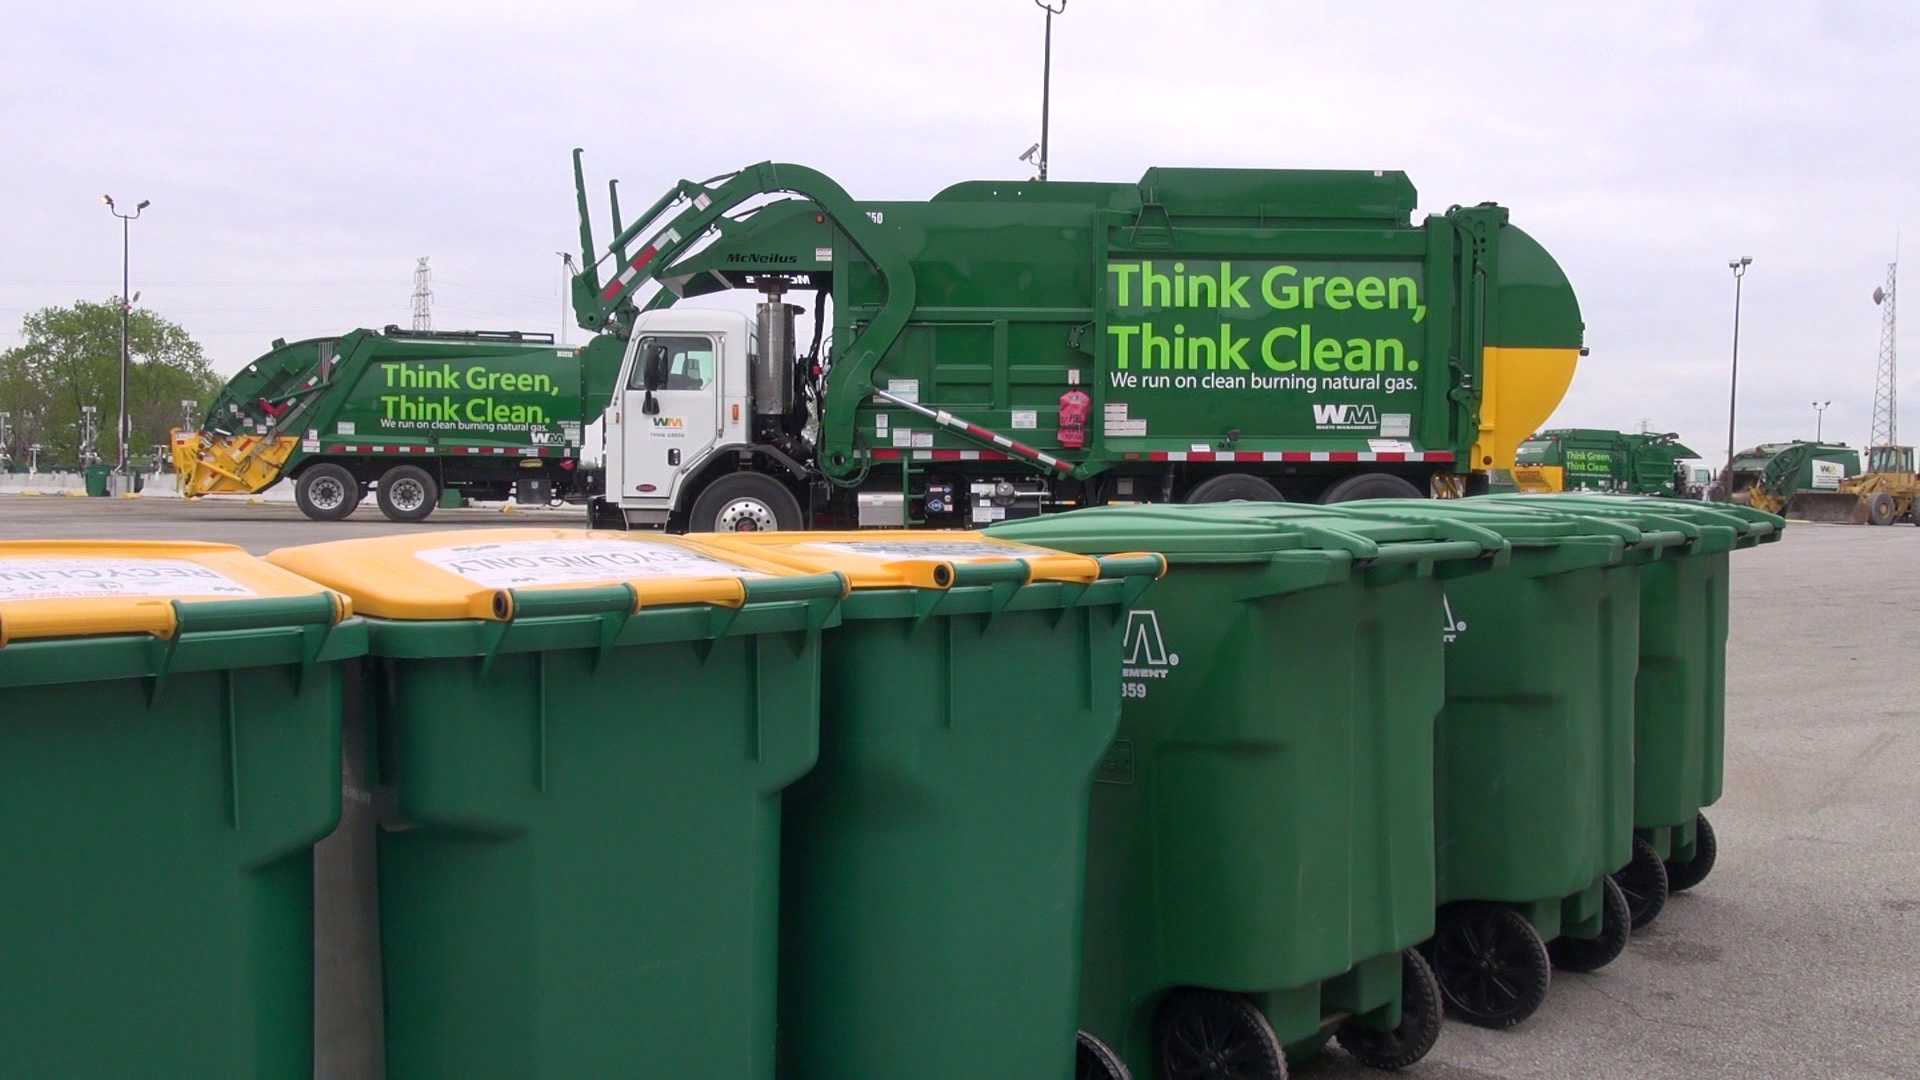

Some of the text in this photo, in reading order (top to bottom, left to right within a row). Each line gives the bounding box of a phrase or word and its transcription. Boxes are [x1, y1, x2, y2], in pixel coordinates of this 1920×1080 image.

[726, 253, 798, 264] McNeilus
[1107, 261, 1427, 324] Think Green,
[1107, 323, 1420, 372] Think Clean.
[380, 363, 560, 396] Think Green,
[1110, 371, 1418, 394] We run on clean burning natural gas.
[380, 396, 551, 424] Think Clean.
[1313, 404, 1377, 425] WM
[380, 418, 550, 434] We run on clean burning natural gas.
[1567, 450, 1586, 460] Think
[1567, 461, 1586, 470] Think
[447, 556, 537, 574] ONLY
[0, 567, 219, 582] RECYCLIN
[1122, 668, 1169, 678] EMENT
